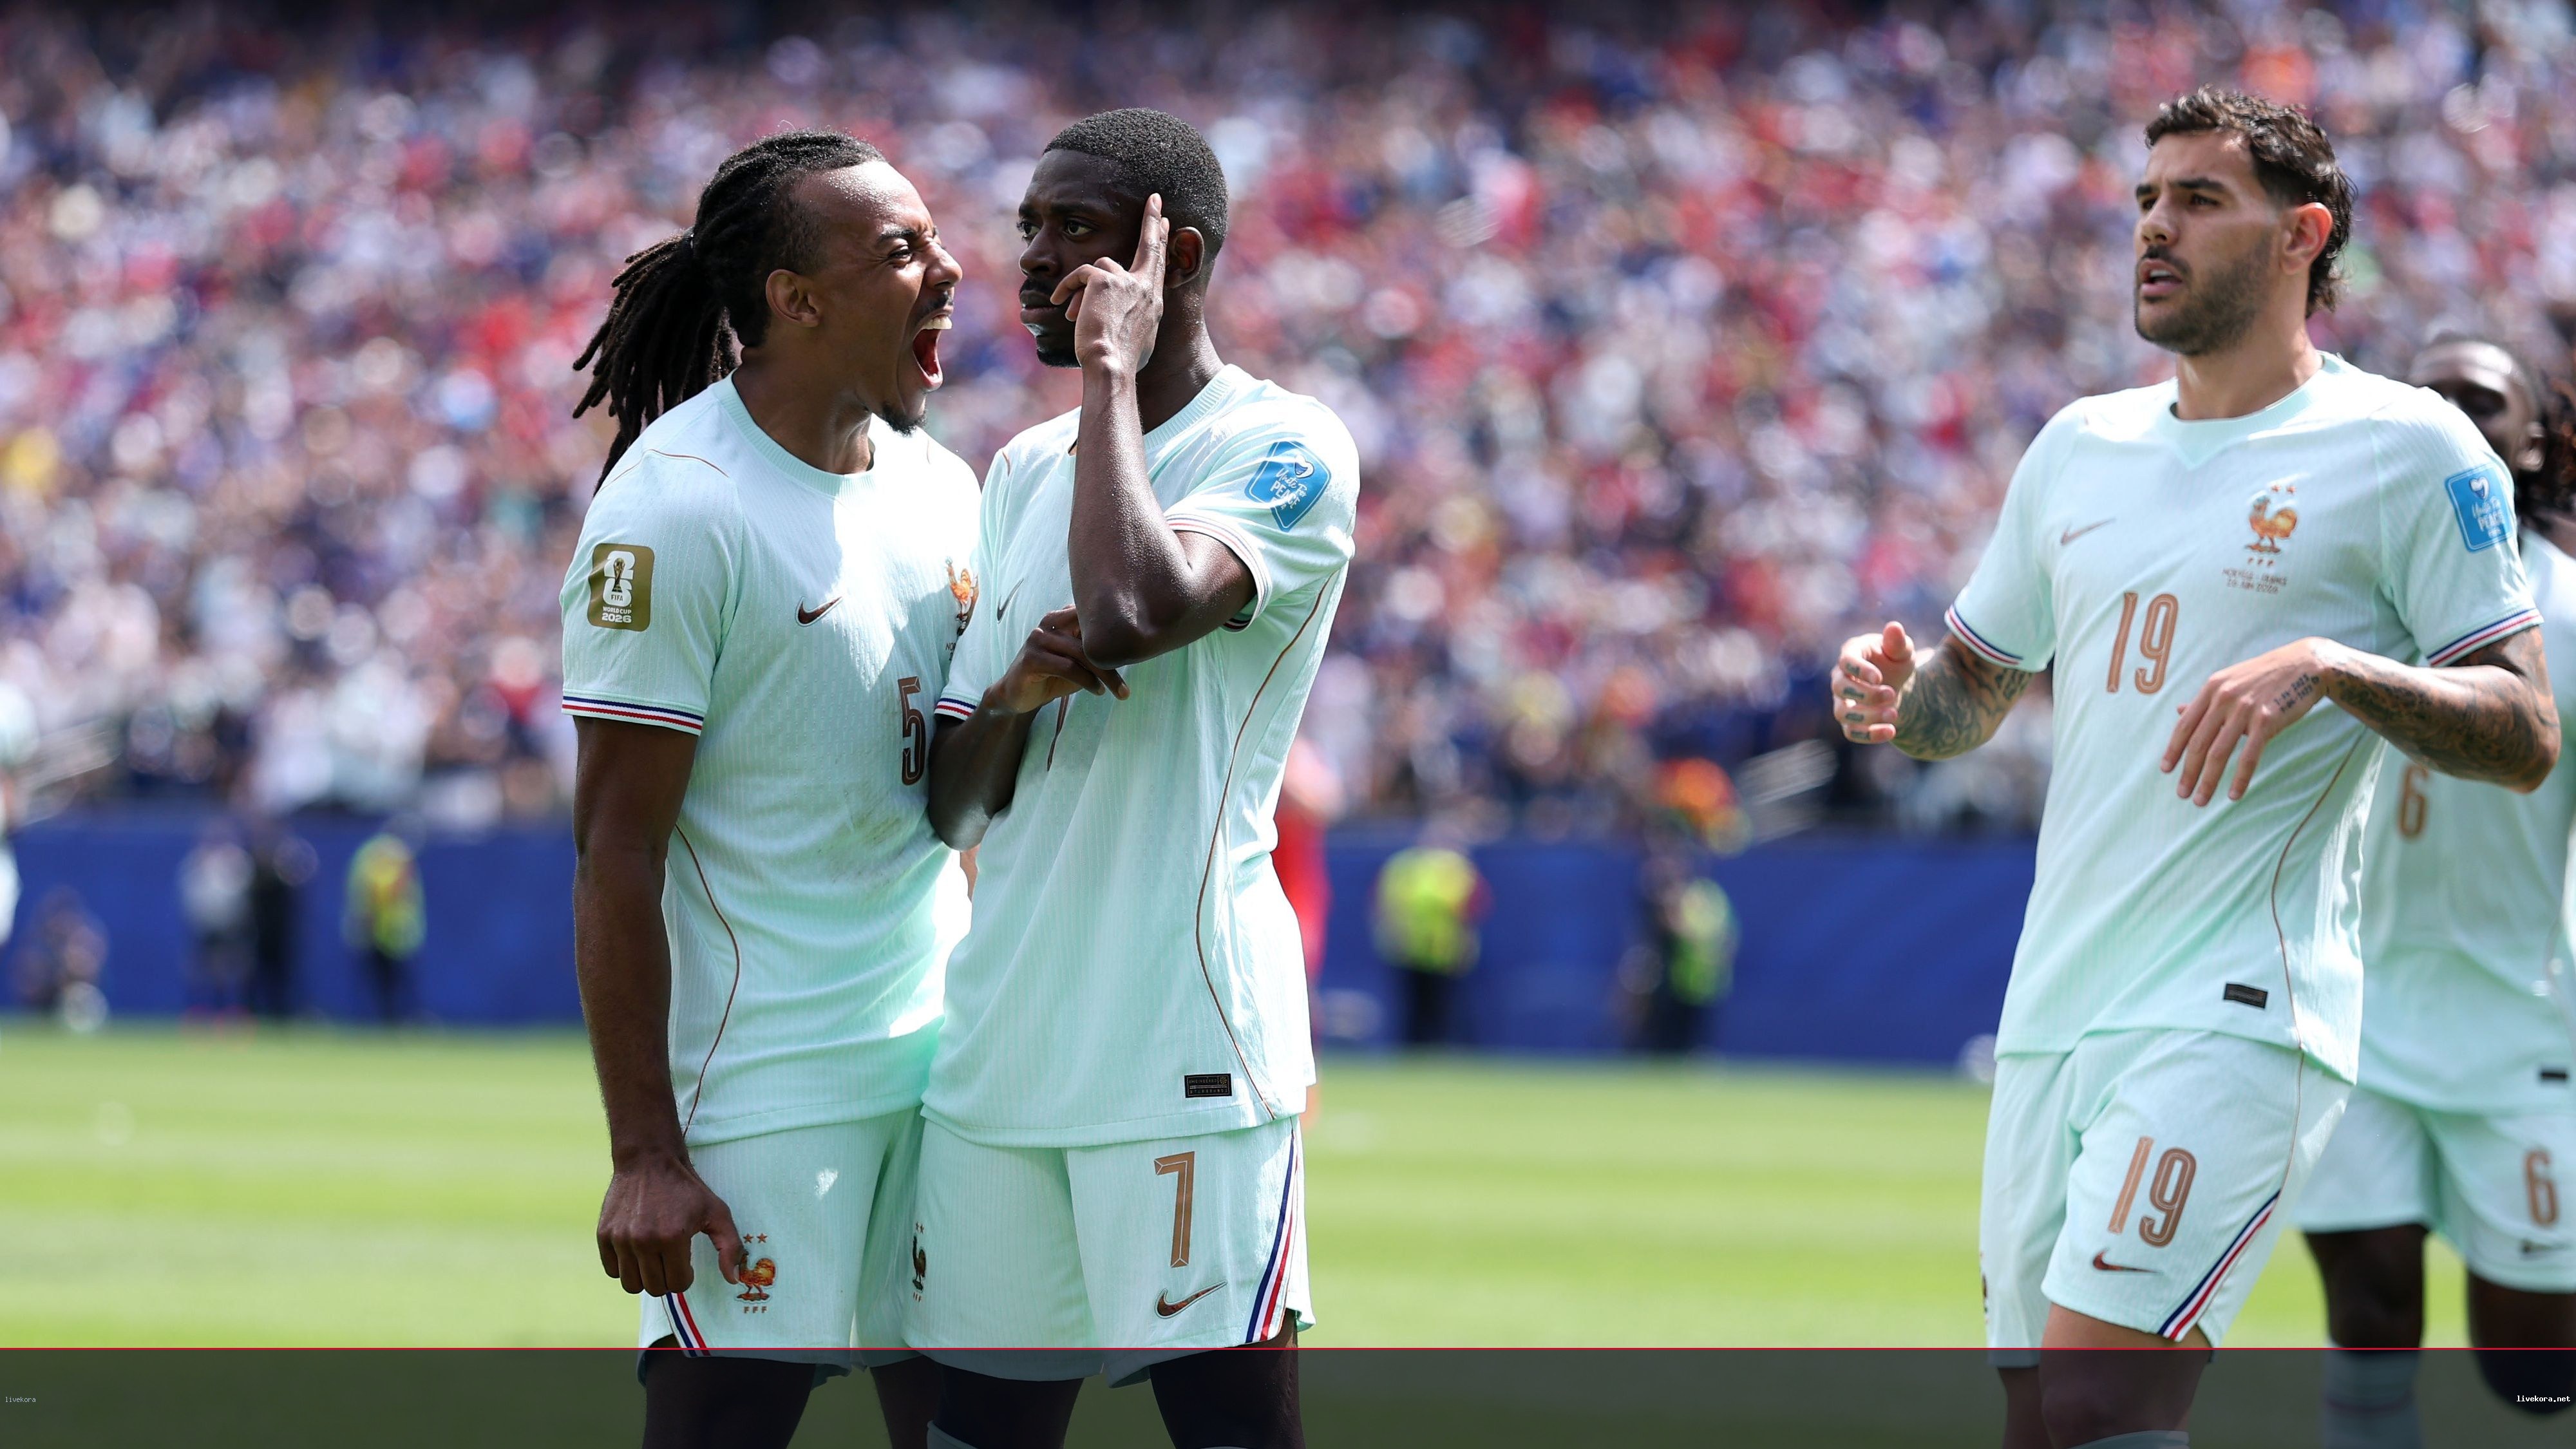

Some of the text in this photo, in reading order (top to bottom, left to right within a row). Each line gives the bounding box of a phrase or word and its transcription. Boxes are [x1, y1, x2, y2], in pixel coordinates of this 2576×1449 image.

[601, 612, 632, 623] 2026
[2107, 592, 2179, 694] 19
[898, 676, 926, 786] 5
[2398, 764, 2429, 840] 6
[1154, 1151, 1195, 1268] 7
[2108, 1136, 2197, 1248] 19
[2523, 1148, 2559, 1228] 6
